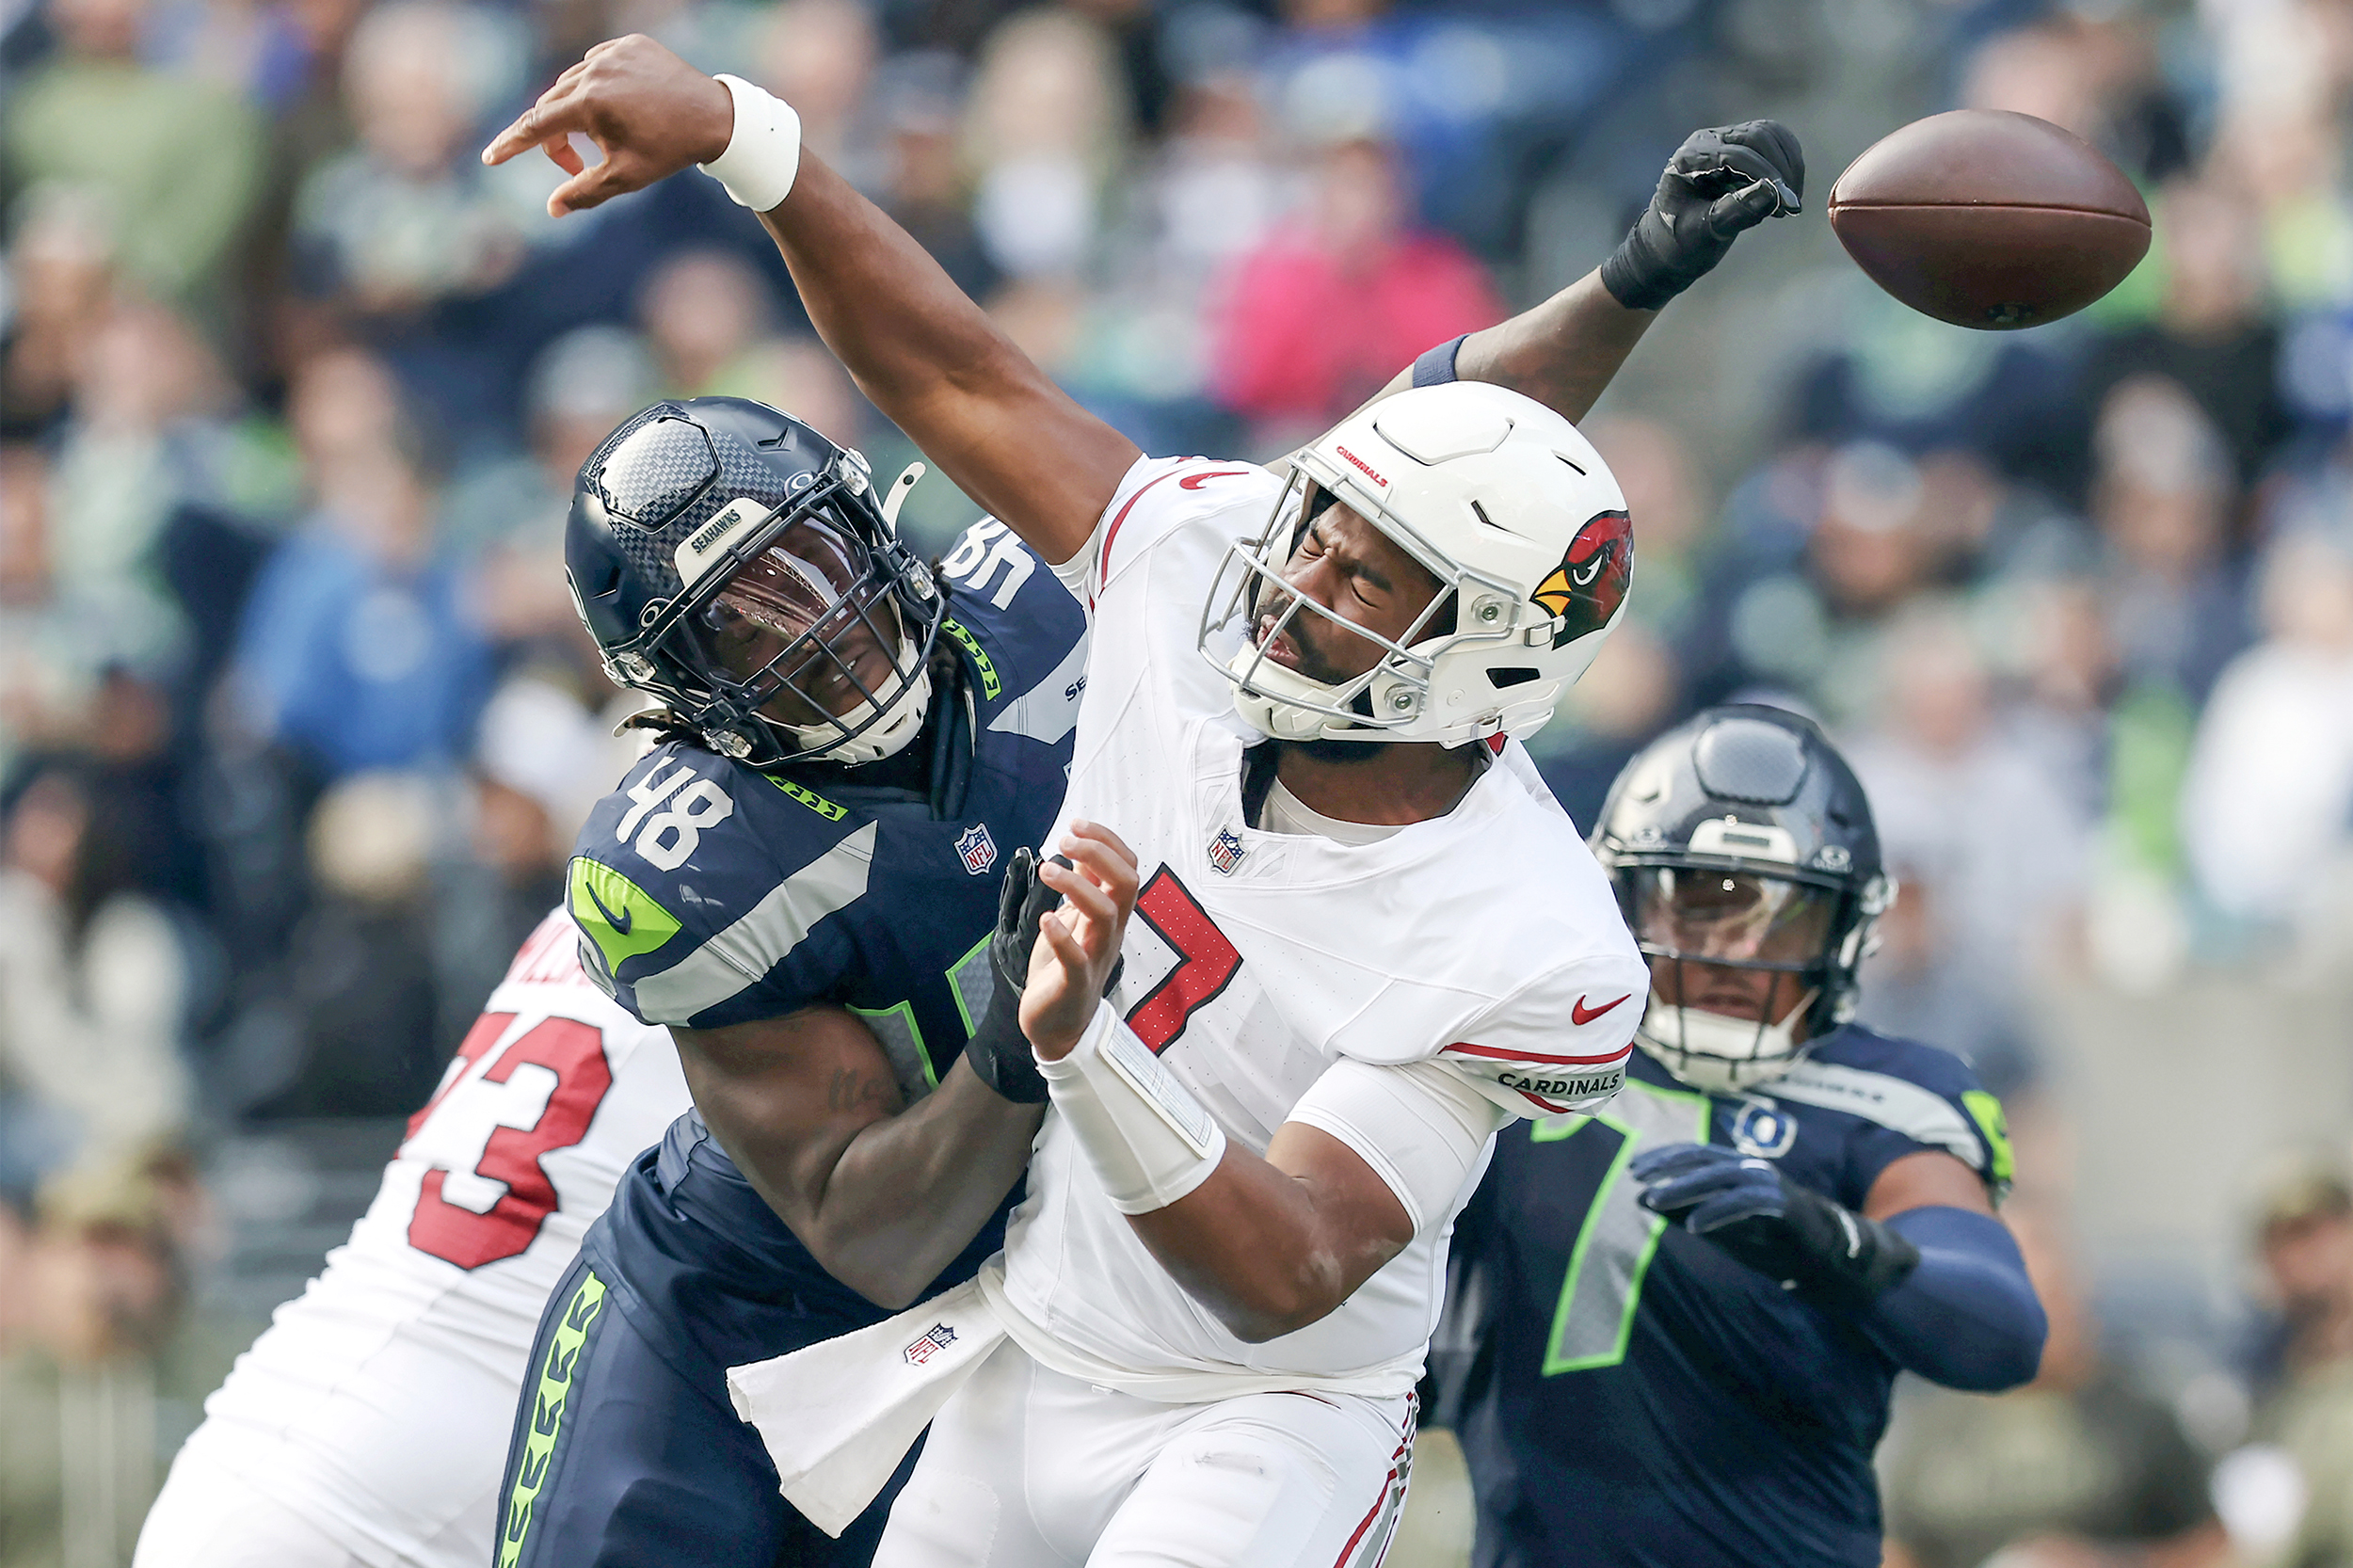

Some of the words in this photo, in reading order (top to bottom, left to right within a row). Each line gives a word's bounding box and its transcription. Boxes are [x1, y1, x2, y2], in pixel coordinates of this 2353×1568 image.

[1337, 445, 1388, 488] CARDINALS
[691, 508, 742, 554] SEAHAWKS
[616, 756, 734, 872] 48
[967, 843, 992, 869] NFL
[1211, 840, 1233, 871] NFL
[1497, 1073, 1621, 1096] CARDINALS
[1529, 1078, 1711, 1378] 7
[908, 1337, 939, 1365] NFL
